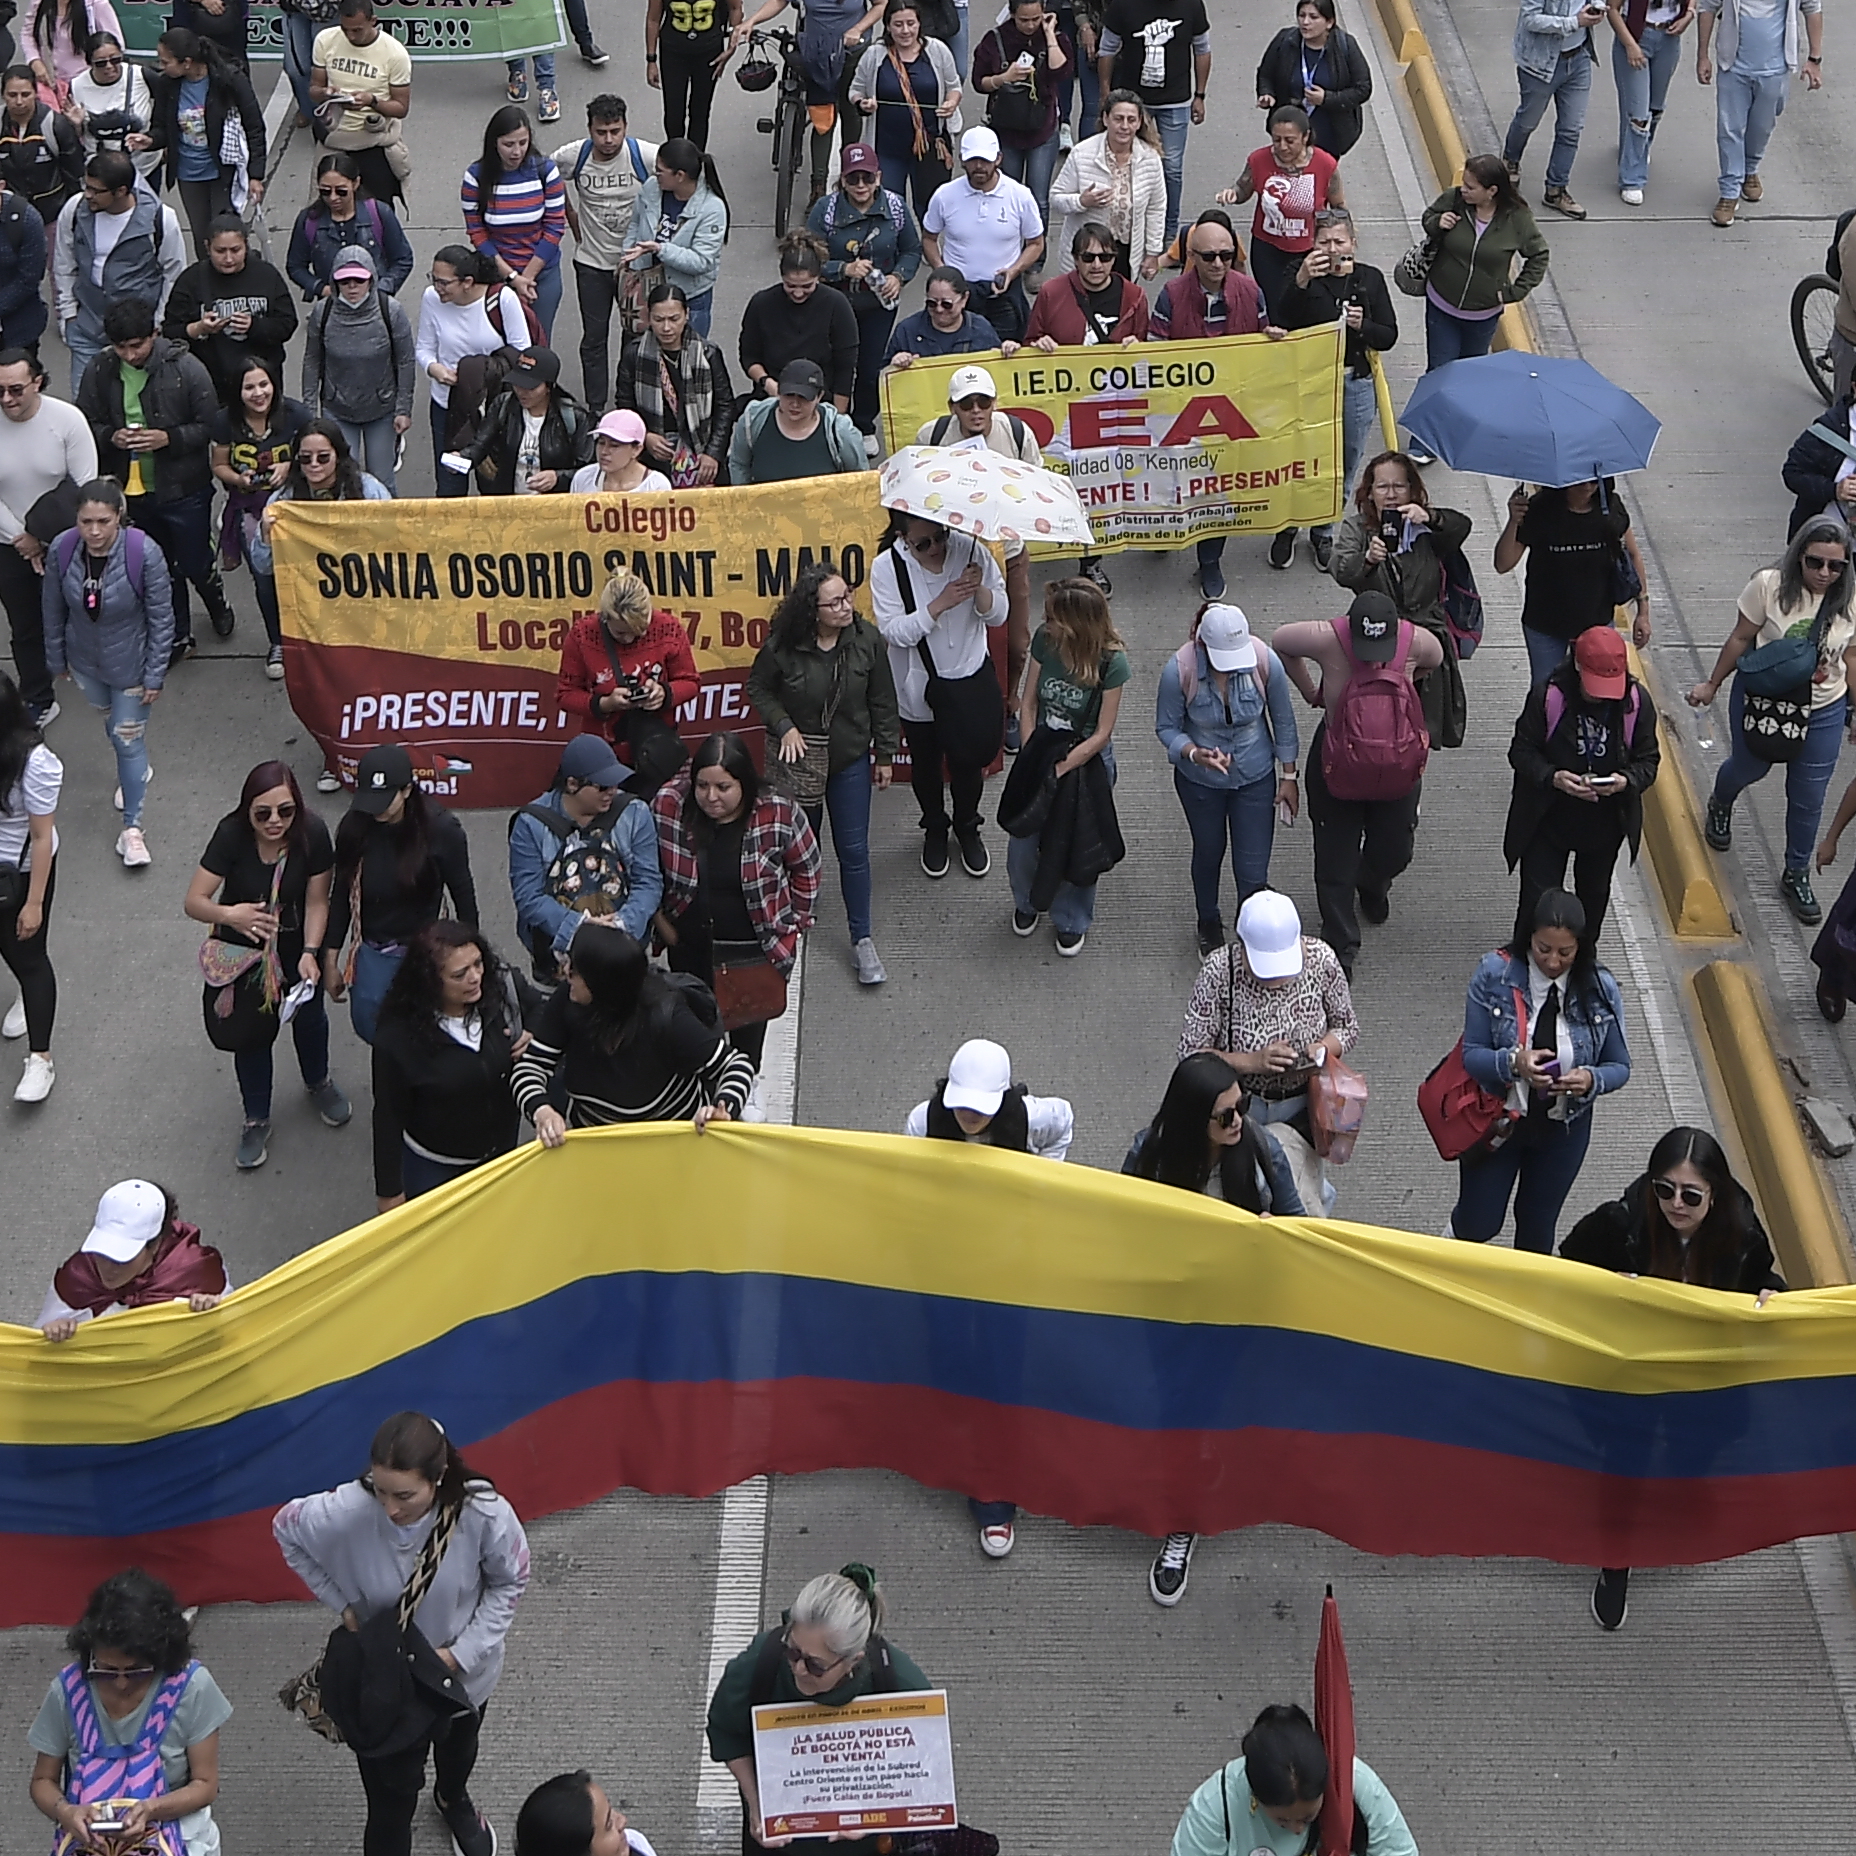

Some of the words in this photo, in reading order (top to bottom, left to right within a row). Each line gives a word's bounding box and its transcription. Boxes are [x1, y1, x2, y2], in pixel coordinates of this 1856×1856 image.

[331, 57, 379, 79] SEATTLE
[1013, 369, 1081, 397] I.E.D.
[1090, 360, 1215, 393] COLEGIO
[1114, 451, 1134, 471] 08
[1190, 460, 1305, 498] PRESENTE
[585, 497, 696, 542] Colegio
[1114, 511, 1160, 526] Distrital
[1164, 513, 1179, 524] de
[1183, 502, 1270, 523] Trabajadores
[1153, 530, 1170, 543] de
[1173, 528, 1186, 540] la
[1188, 517, 1253, 538] Educación
[316, 550, 439, 601] SONIA
[449, 549, 592, 599] OSORIO
[603, 548, 717, 598] SAINT
[341, 689, 547, 739] ¡PRESENTE,
[791, 1745, 807, 1755] DE
[811, 1740, 861, 1754] BOGOTÁ
[864, 1741, 882, 1749] NO
[887, 1735, 915, 1748] ESTÁ
[793, 1732, 812, 1745] ¡LA
[816, 1730, 855, 1742] SALUD
[859, 1726, 911, 1739] PÚBLICA
[823, 1754, 838, 1763] EN
[842, 1751, 886, 1762] VENTA!
[783, 1777, 814, 1787] Centro
[816, 1774, 850, 1784] Oriente
[880, 1773, 902, 1783] paso
[904, 1770, 929, 1778] hacia
[790, 1769, 801, 1777] La
[803, 1763, 861, 1776] intervención
[864, 1763, 874, 1772] de
[877, 1762, 886, 1770] la
[888, 1761, 921, 1770] Subred
[803, 1794, 832, 1804] ¡Fuera
[834, 1791, 860, 1801] Galán
[862, 1791, 873, 1799] de
[876, 1789, 912, 1800] Bogotá!
